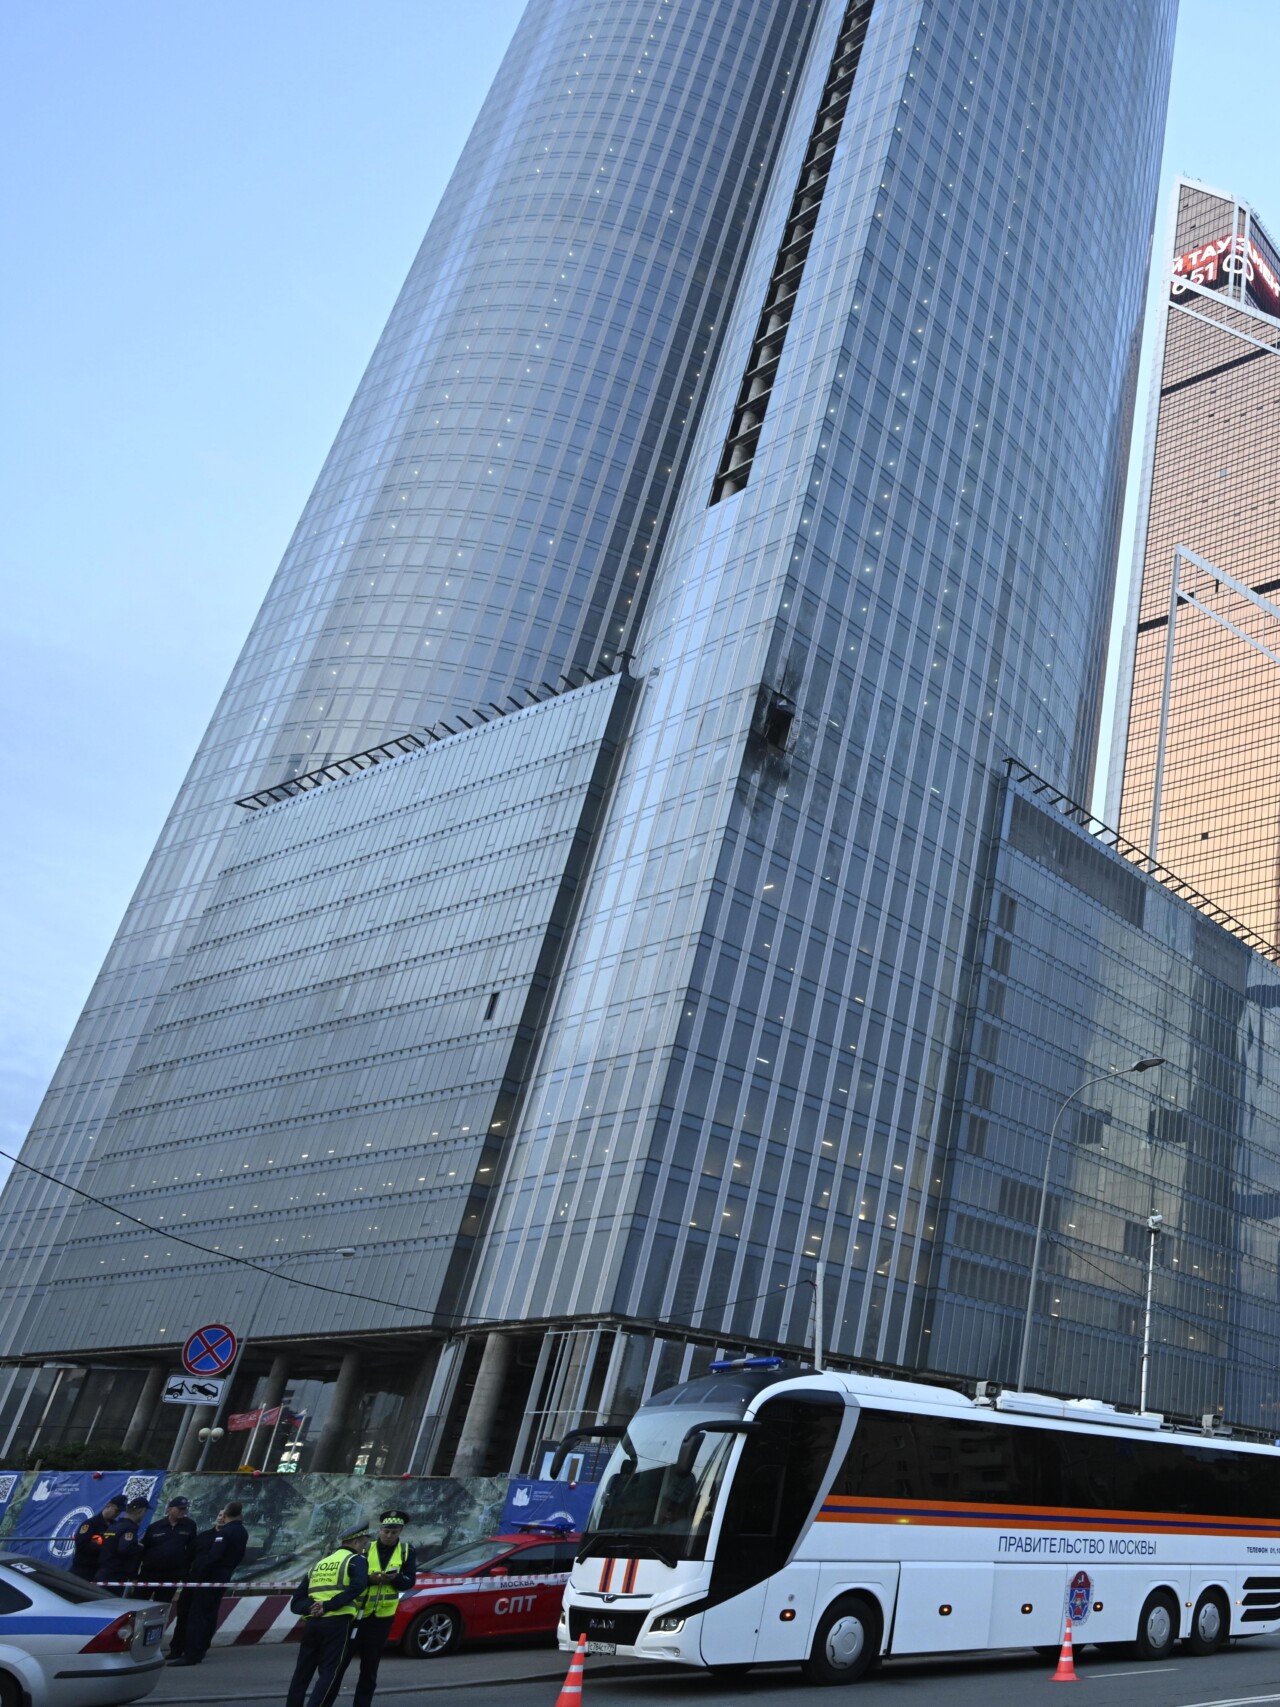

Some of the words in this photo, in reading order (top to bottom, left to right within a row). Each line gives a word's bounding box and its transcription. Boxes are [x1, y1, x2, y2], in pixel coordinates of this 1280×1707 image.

[998, 1535, 1105, 1554] ПРАВИТЕЛЬСТВО
[1108, 1539, 1157, 1555] МОСКВЫ
[1246, 1546, 1268, 1554] ТЕЛЕФОН
[500, 1580, 535, 1589] МОСКВА
[494, 1595, 537, 1616] СПТ
